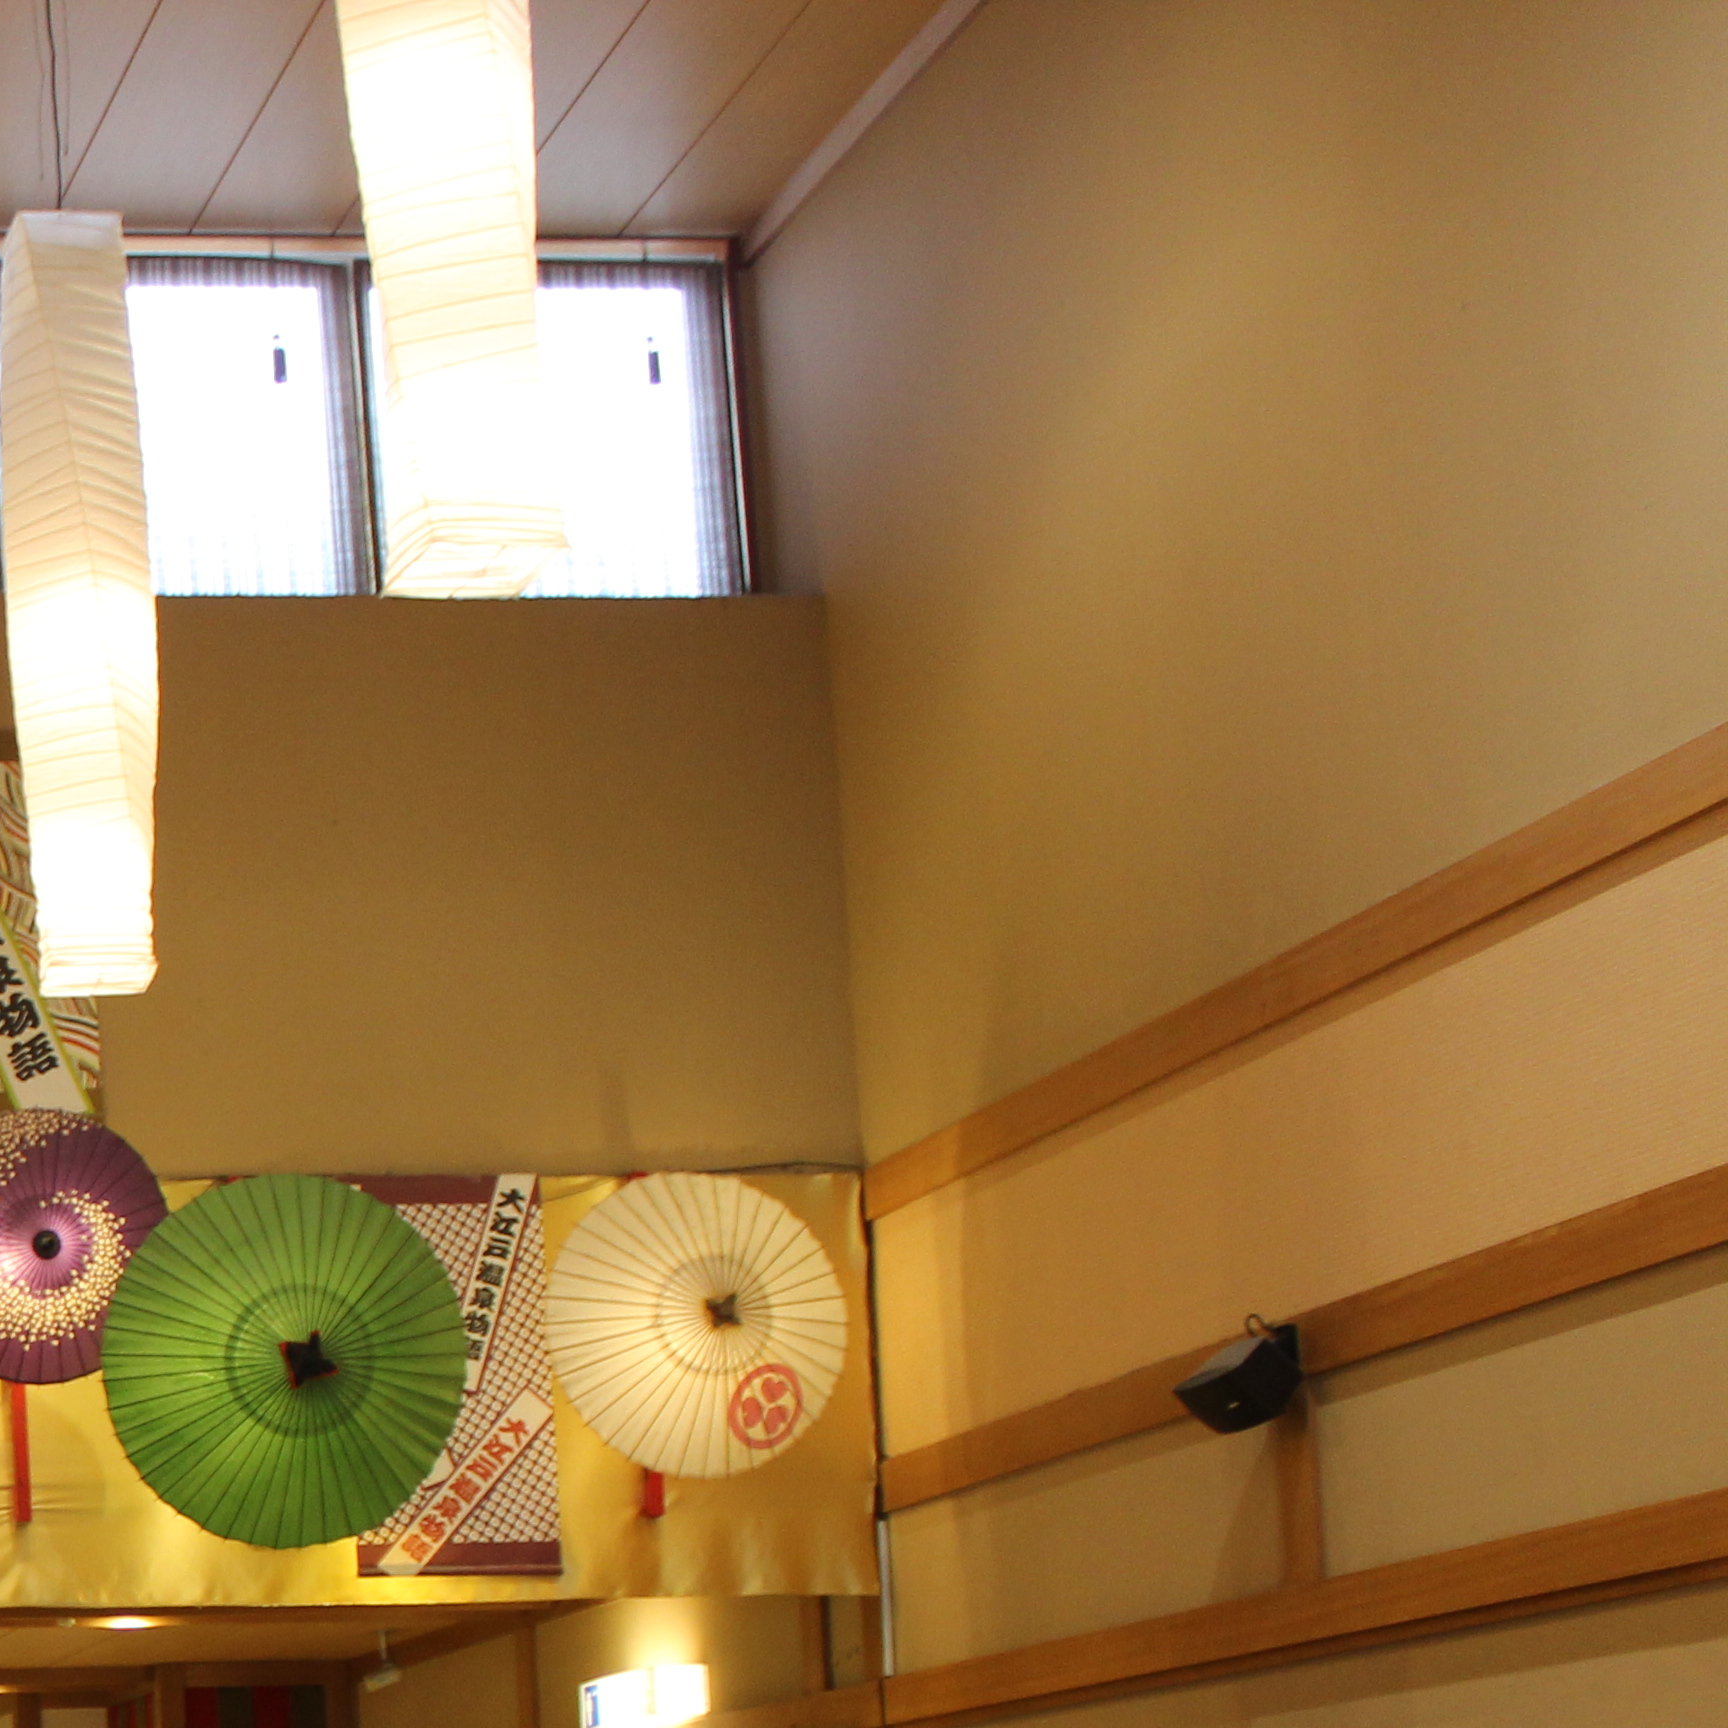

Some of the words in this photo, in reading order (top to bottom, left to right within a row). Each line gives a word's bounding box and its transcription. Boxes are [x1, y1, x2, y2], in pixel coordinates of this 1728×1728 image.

[401, 1416, 530, 1562] 大江戸温泉物語
